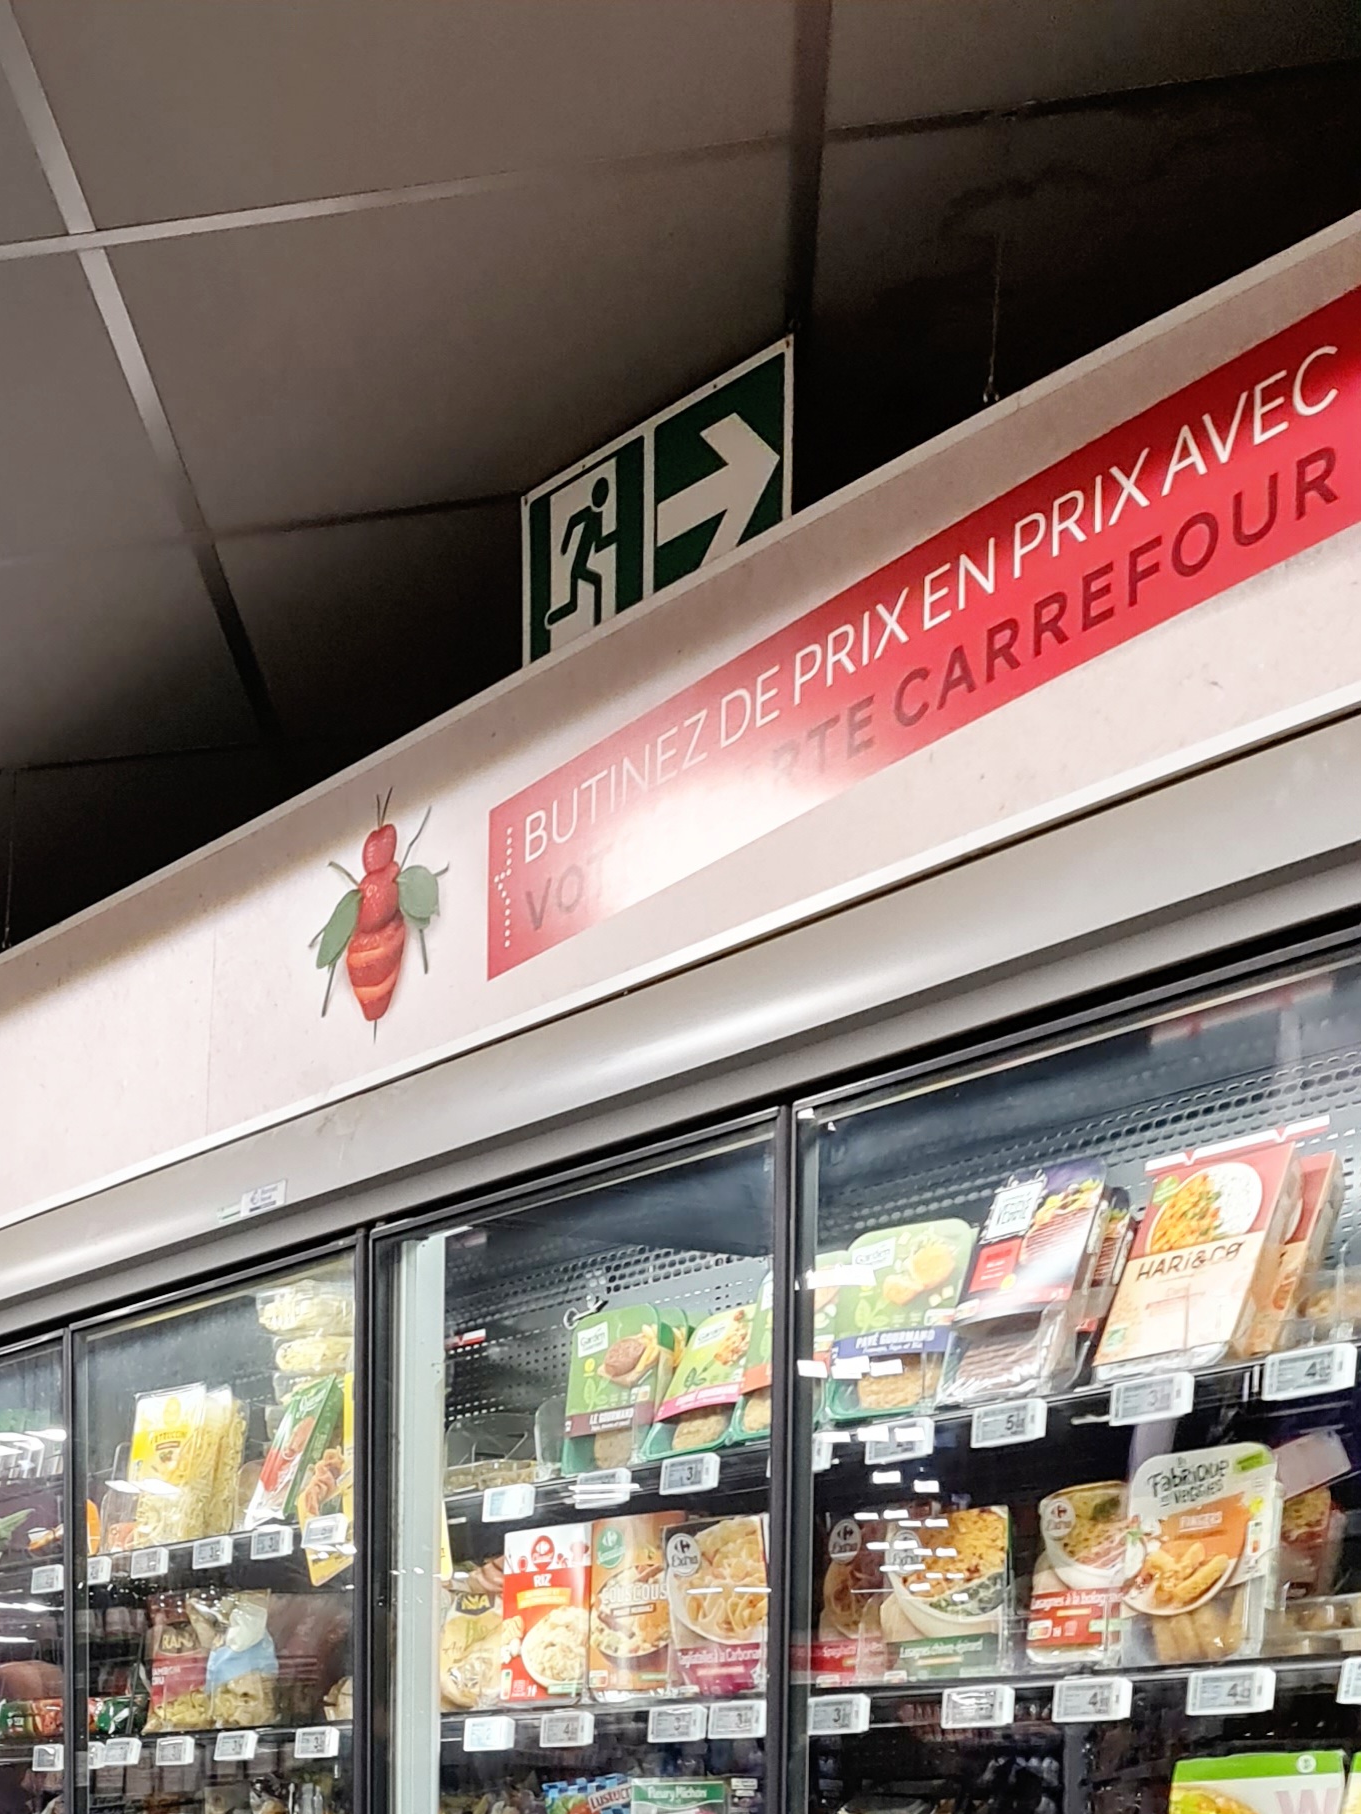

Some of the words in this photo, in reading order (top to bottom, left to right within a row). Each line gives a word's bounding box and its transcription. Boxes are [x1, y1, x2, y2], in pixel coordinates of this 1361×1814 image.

[524, 709, 708, 864] BUTINEZ
[720, 664, 780, 748] DE
[793, 587, 909, 706] PRIX
[922, 537, 996, 632] EN
[1012, 446, 1151, 580] PRIX
[1160, 345, 1339, 498] AVEC
[893, 446, 1339, 728] CARREFOUR
[161, 1633, 194, 1650] RAN
[532, 1573, 553, 1588] RIZ
